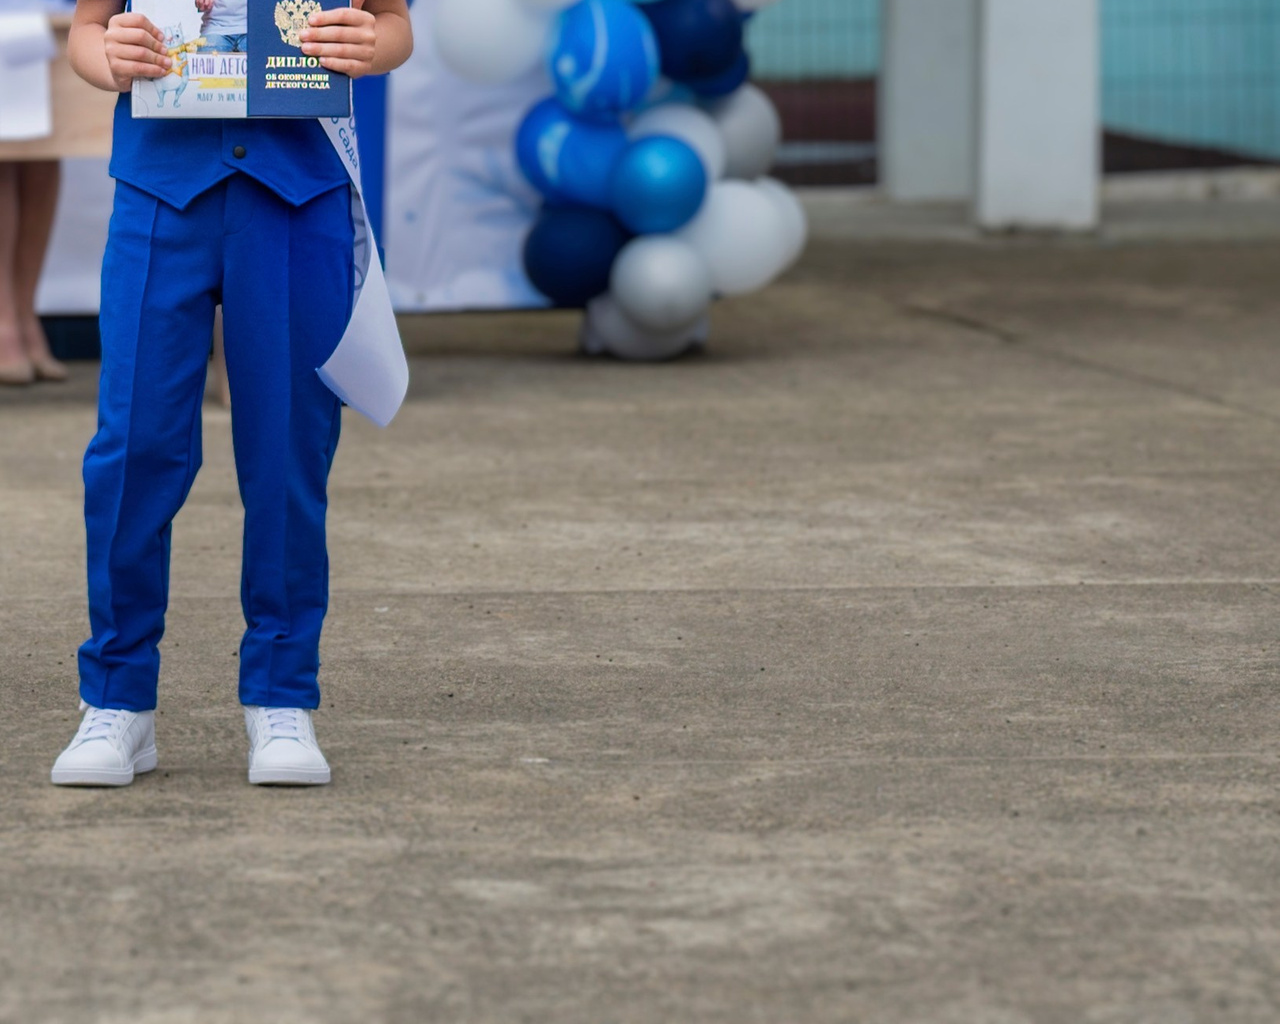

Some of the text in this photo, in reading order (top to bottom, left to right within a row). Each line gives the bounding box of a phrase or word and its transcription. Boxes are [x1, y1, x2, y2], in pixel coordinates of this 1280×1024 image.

[191, 57, 248, 76] НАШ ДЕТС
[265, 56, 322, 69] ДИПЛО
[265, 72, 329, 82] ОБ ОКОНЧАНИИ
[265, 81, 330, 90] ДЕТСКОГО САДА
[338, 127, 358, 169] сада
